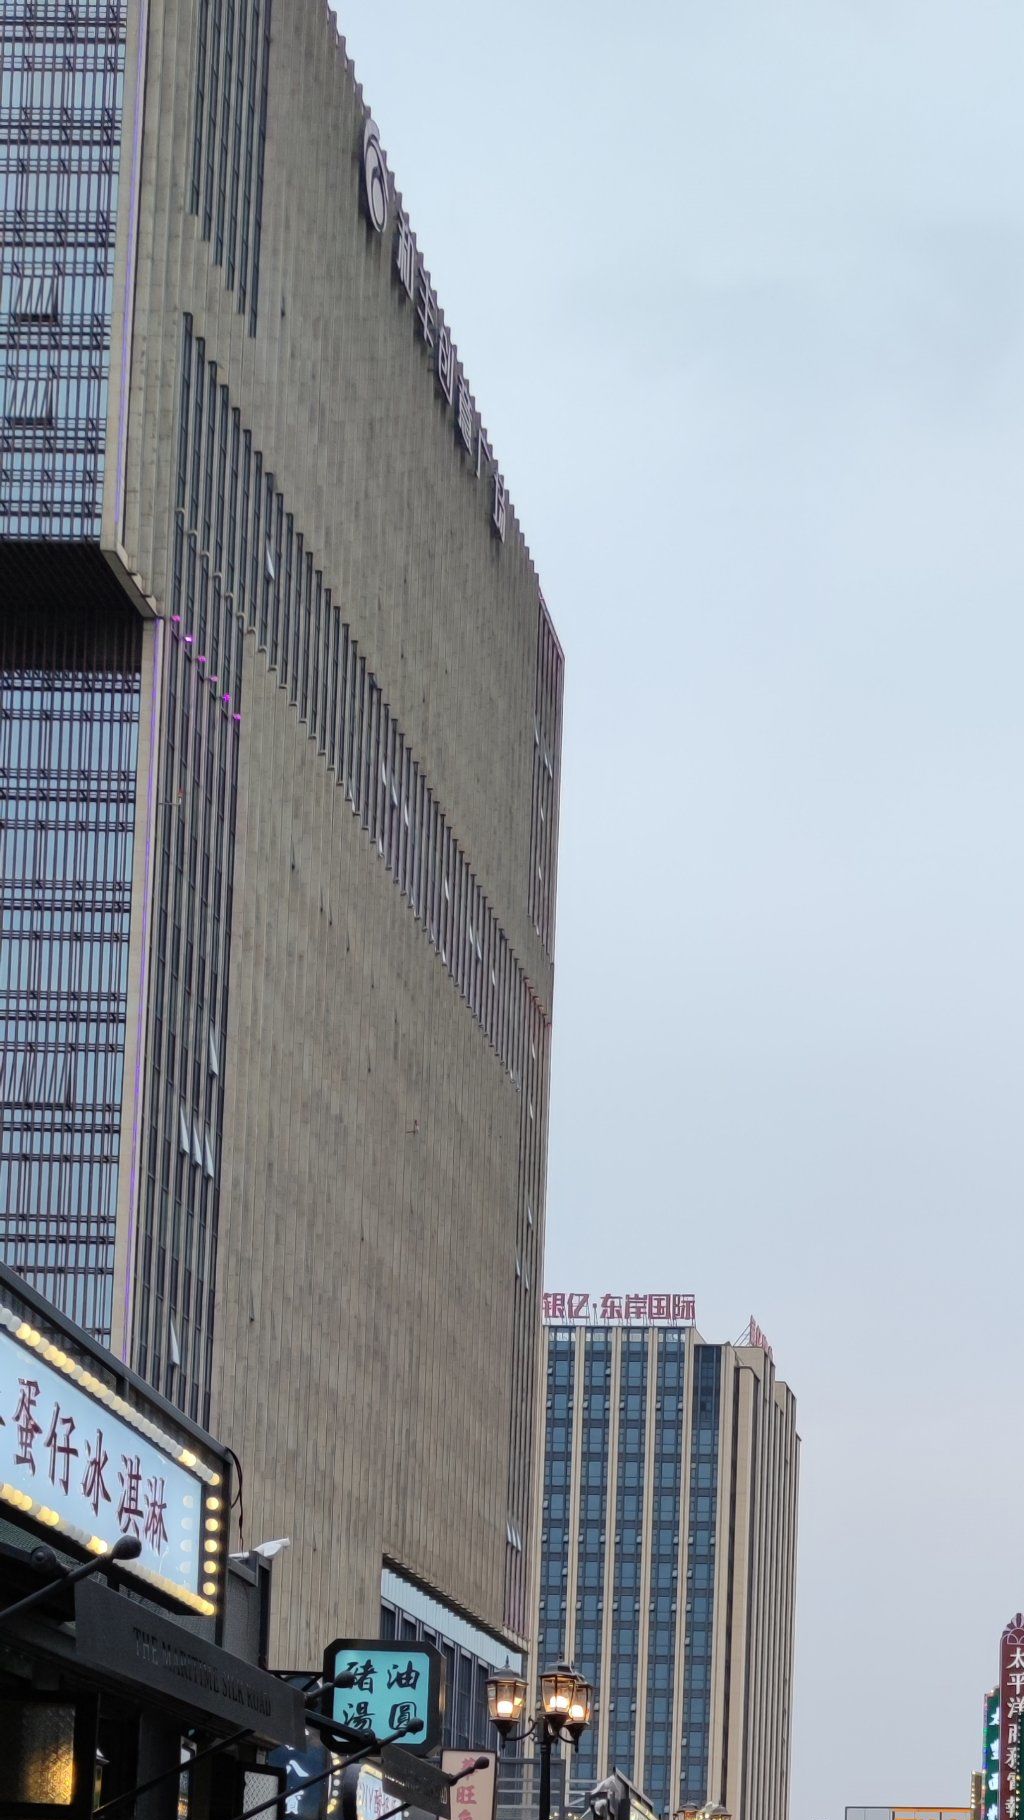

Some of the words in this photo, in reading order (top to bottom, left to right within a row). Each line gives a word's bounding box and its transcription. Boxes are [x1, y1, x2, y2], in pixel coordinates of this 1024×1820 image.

[0, 1376, 169, 1556] 蛋仔冰淇淋
